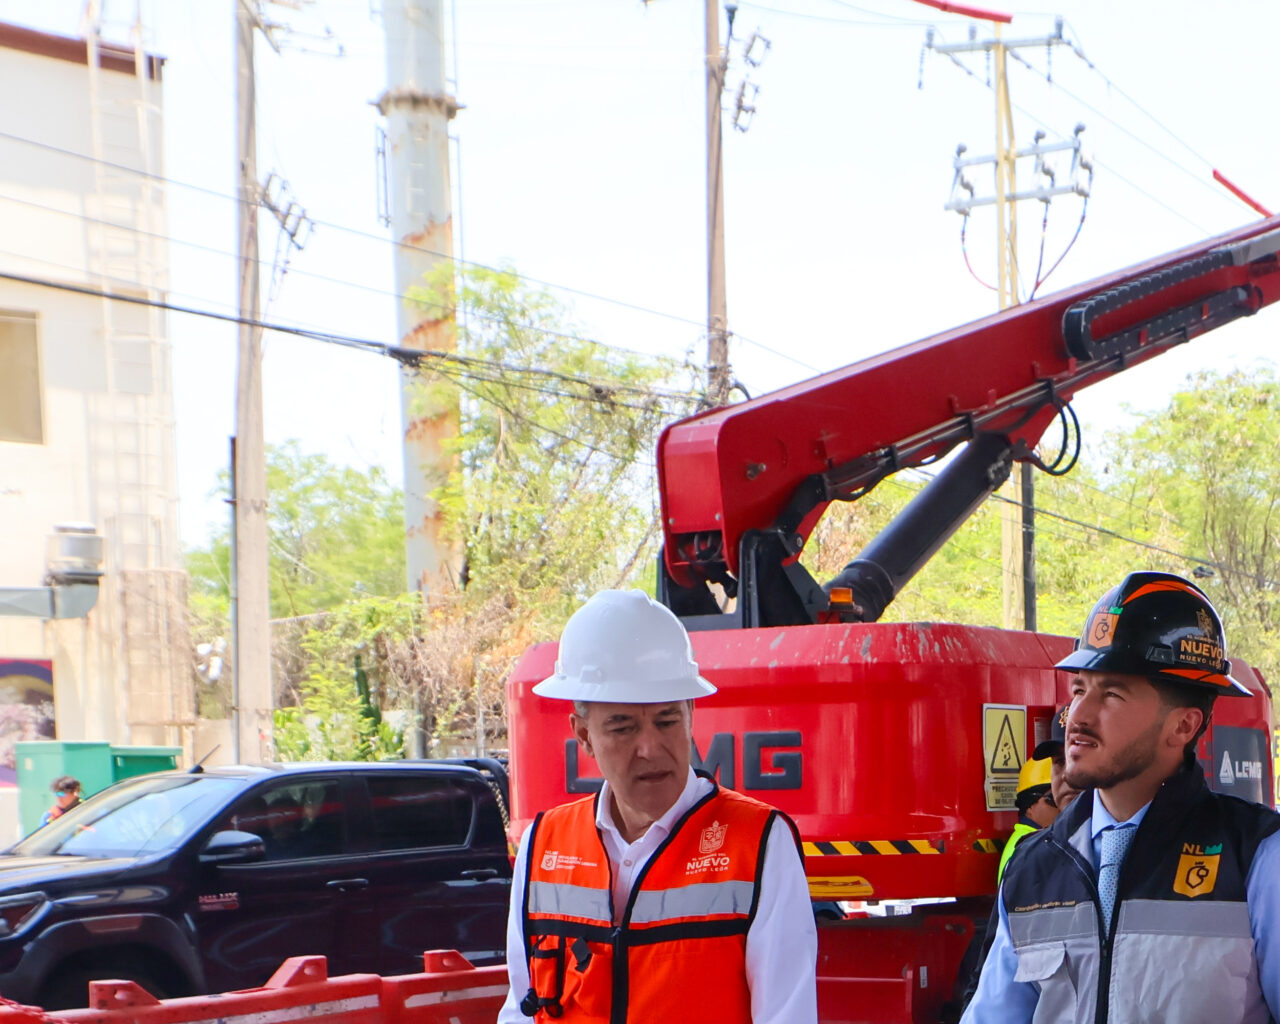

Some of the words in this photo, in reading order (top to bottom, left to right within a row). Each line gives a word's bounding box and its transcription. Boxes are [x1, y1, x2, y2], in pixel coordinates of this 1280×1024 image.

[1180, 640, 1223, 660] NUEVO
[1180, 654, 1207, 664] NUEVO
[565, 731, 803, 794] LMG
[1182, 842, 1204, 855] NL
[686, 856, 730, 870] NUEVO
